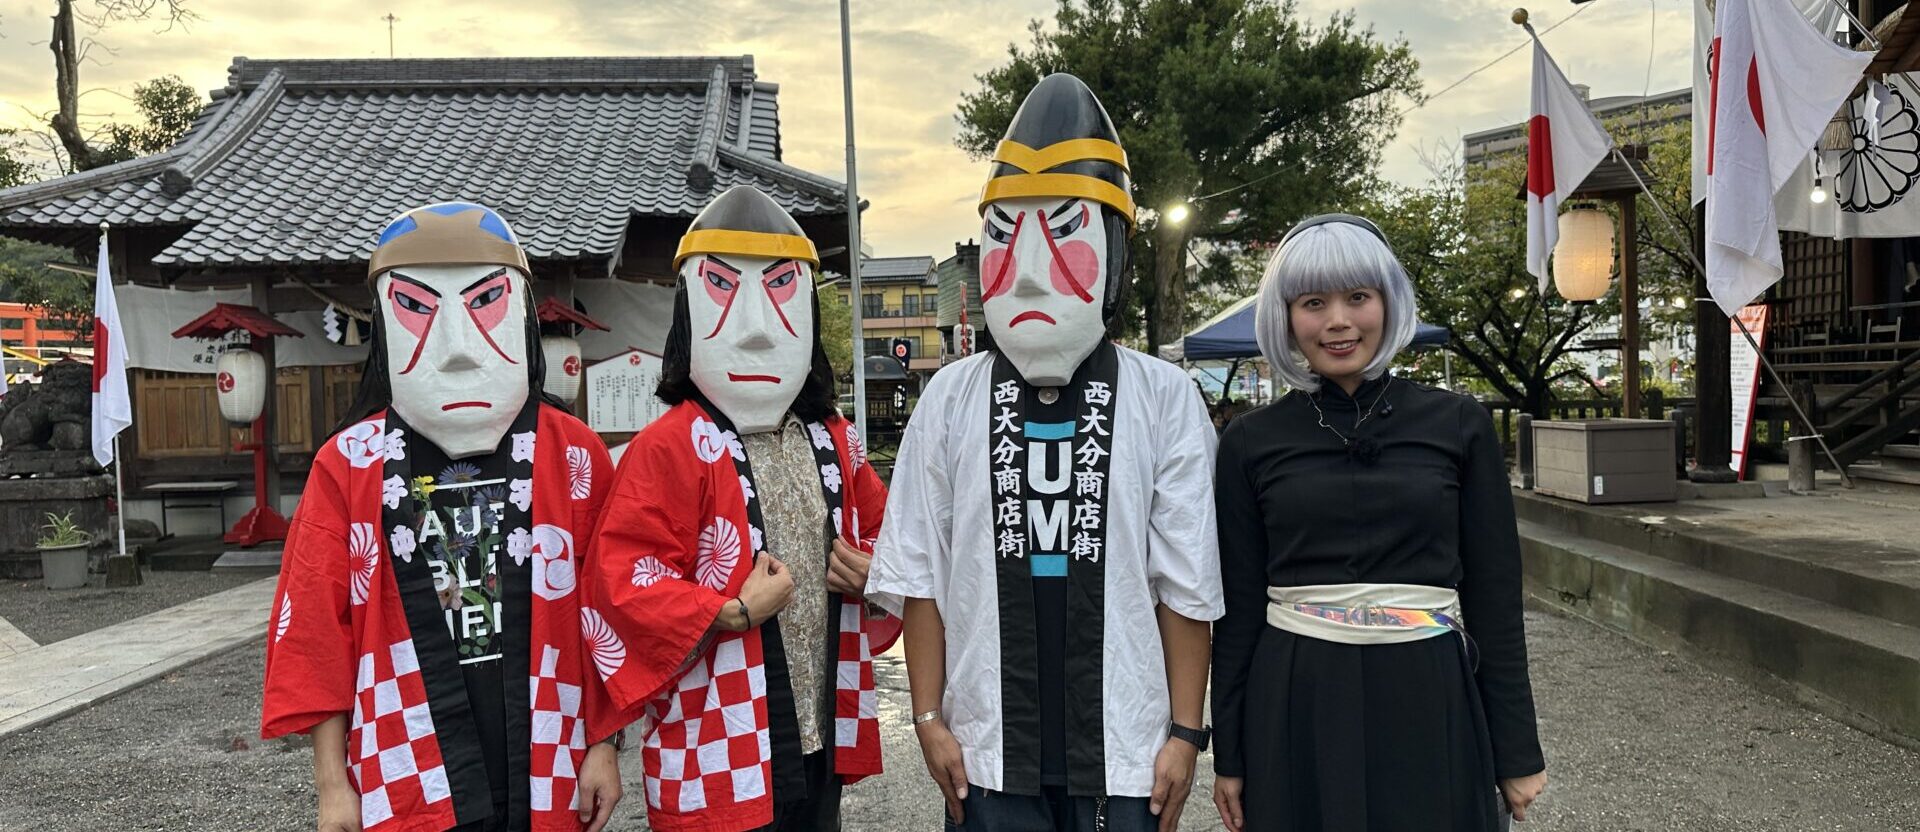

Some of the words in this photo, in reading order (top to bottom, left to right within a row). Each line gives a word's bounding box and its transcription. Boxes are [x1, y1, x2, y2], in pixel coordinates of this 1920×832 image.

[991, 379, 1027, 559] 西大分商店街
[1069, 380, 1112, 563] 西大分商店街
